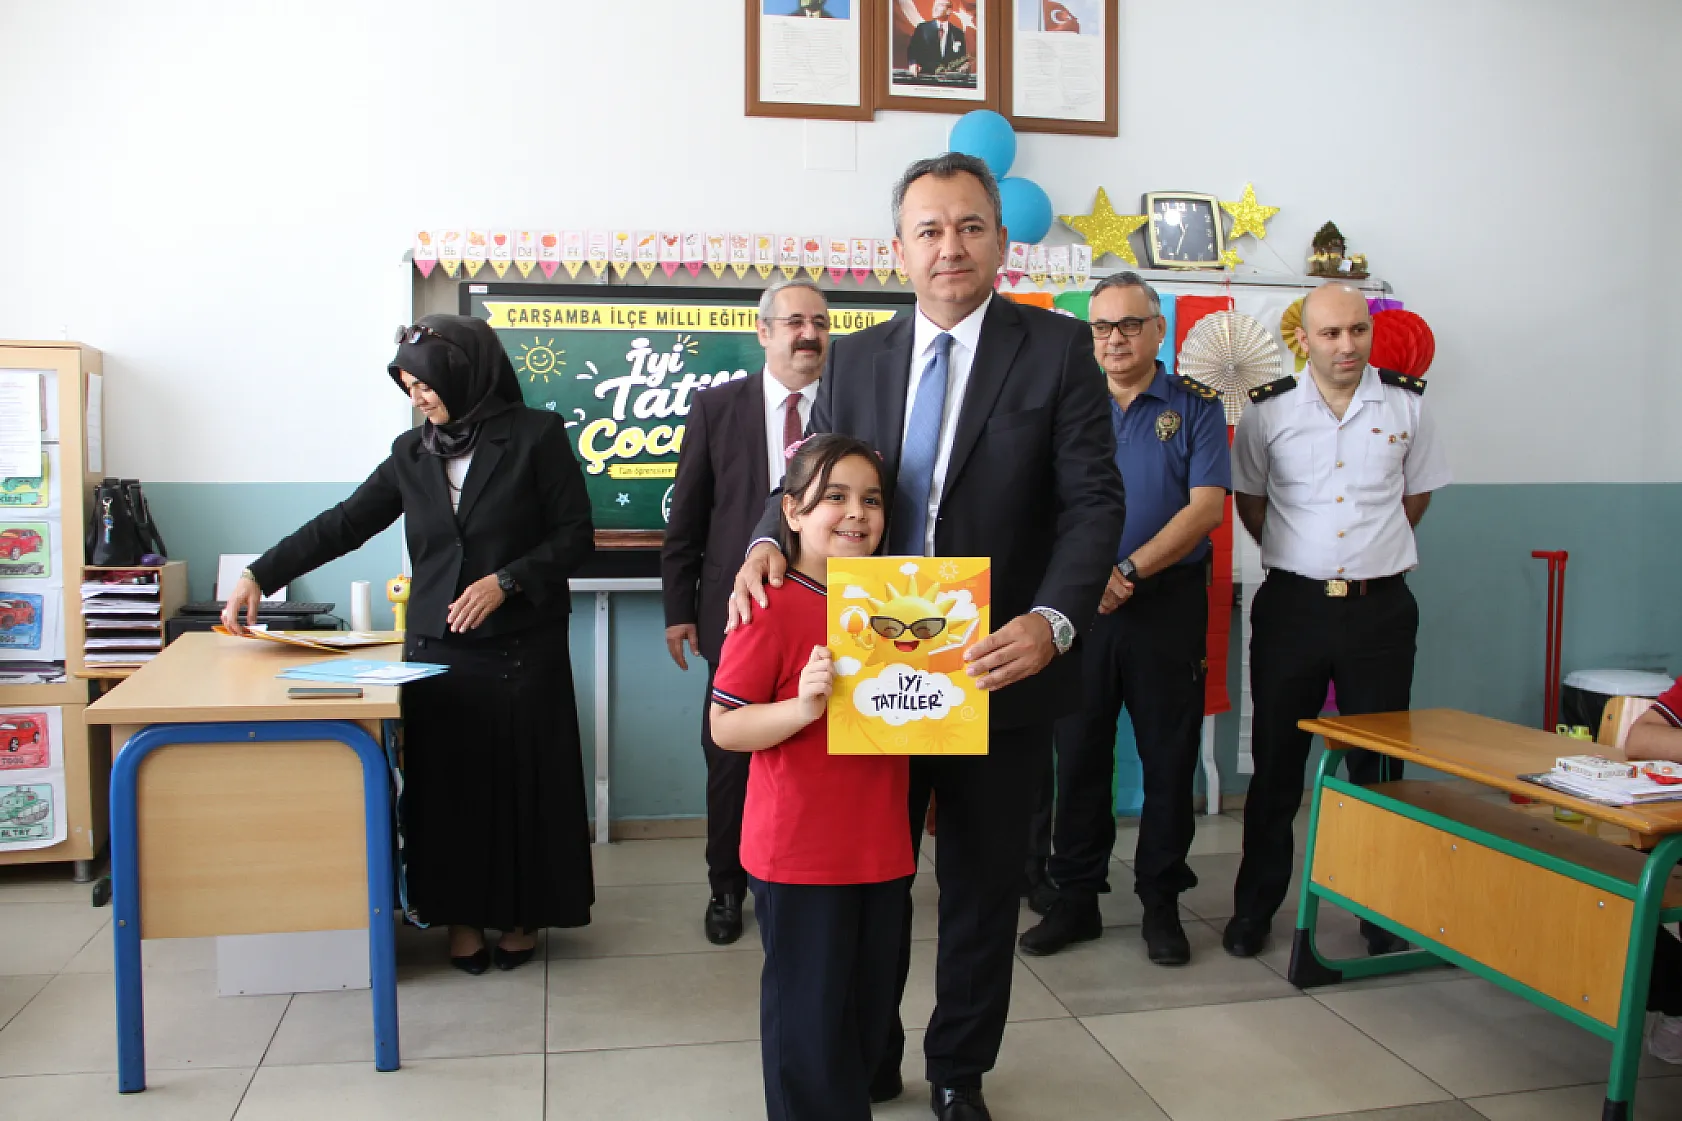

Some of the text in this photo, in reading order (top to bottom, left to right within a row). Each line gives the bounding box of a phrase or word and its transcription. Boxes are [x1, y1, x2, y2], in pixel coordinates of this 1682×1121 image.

[507, 308, 602, 328] ÇARŞAMBA
[610, 307, 648, 329] İLÇE
[656, 308, 701, 327] MİLLİ
[625, 337, 685, 388] İyi
[898, 673, 922, 692] İYİ
